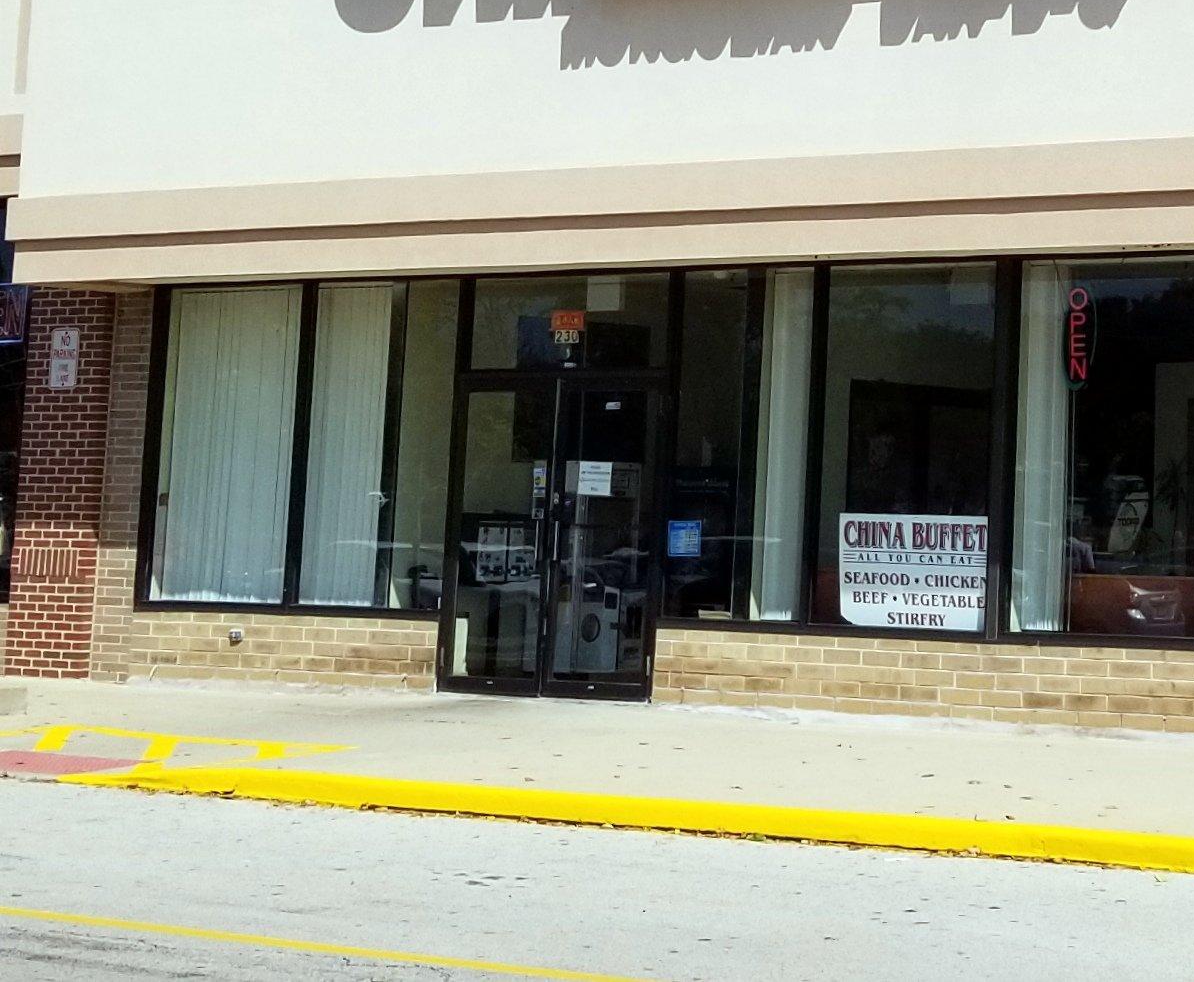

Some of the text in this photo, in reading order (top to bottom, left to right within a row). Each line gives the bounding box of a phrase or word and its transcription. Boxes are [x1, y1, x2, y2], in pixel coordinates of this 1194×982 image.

[555, 330, 578, 343] 230
[1068, 287, 1089, 381] OPEN
[843, 520, 988, 552] CHINA BUFFET
[857, 553, 974, 565] ALL YOU CAN EAT
[843, 571, 911, 586] SEAFOOD
[852, 591, 986, 609] BEEF VEGETABLE
[887, 612, 946, 627] STIRFRY
